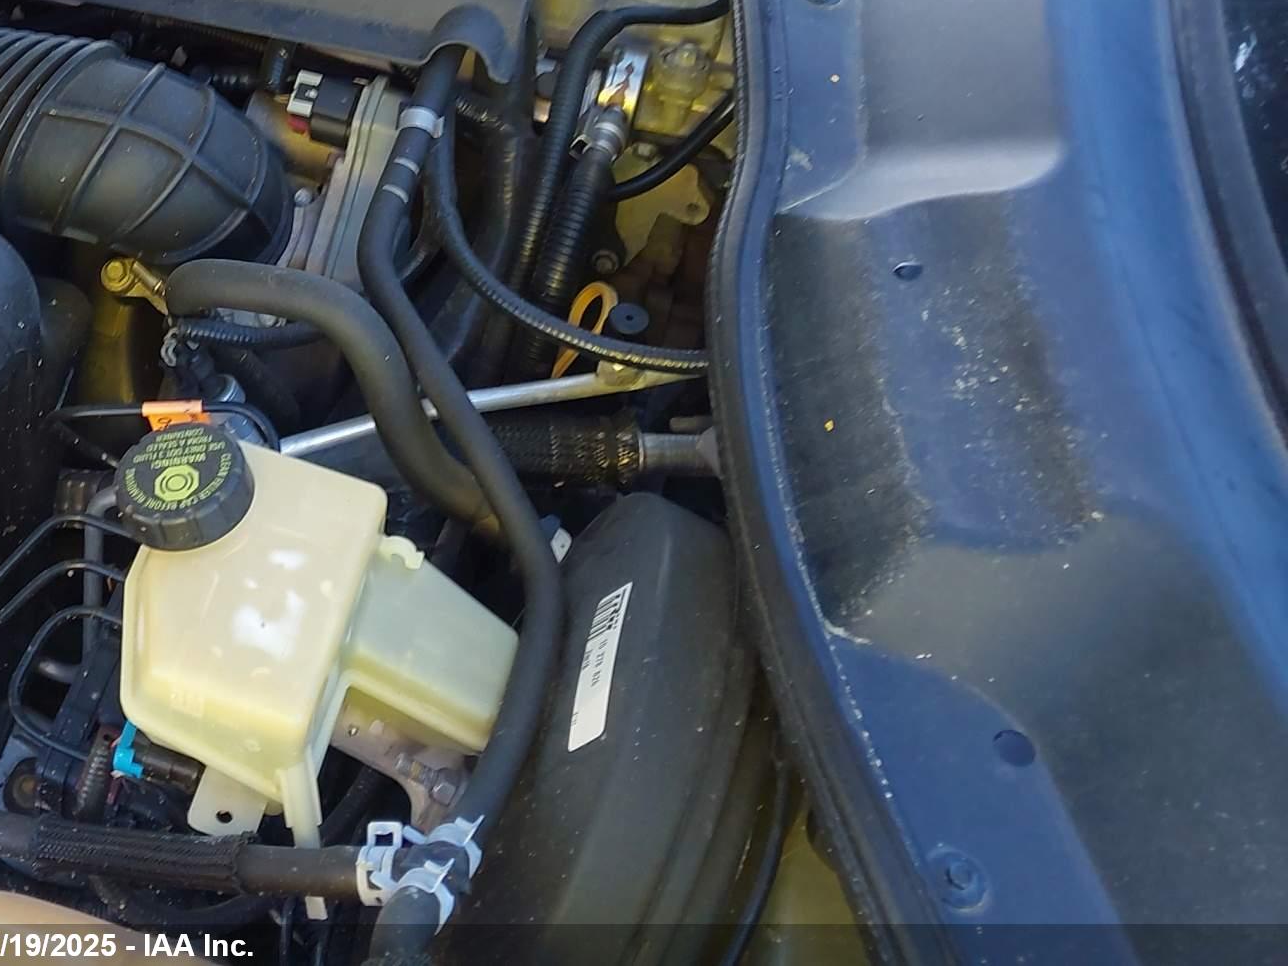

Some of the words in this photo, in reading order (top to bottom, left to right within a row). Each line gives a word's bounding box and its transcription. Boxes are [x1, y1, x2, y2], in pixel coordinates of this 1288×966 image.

[155, 427, 204, 443] CONTAINER
[186, 435, 212, 446] FROM
[146, 441, 178, 453] SEALED
[184, 444, 207, 455] ONLY
[207, 441, 226, 452] USE
[133, 452, 157, 463] FLUID
[167, 447, 183, 459] DOT
[151, 452, 206, 470] WARNING!
[125, 467, 146, 504] REMOVING
[145, 497, 178, 511] BEFORE
[179, 494, 199, 509] CAP
